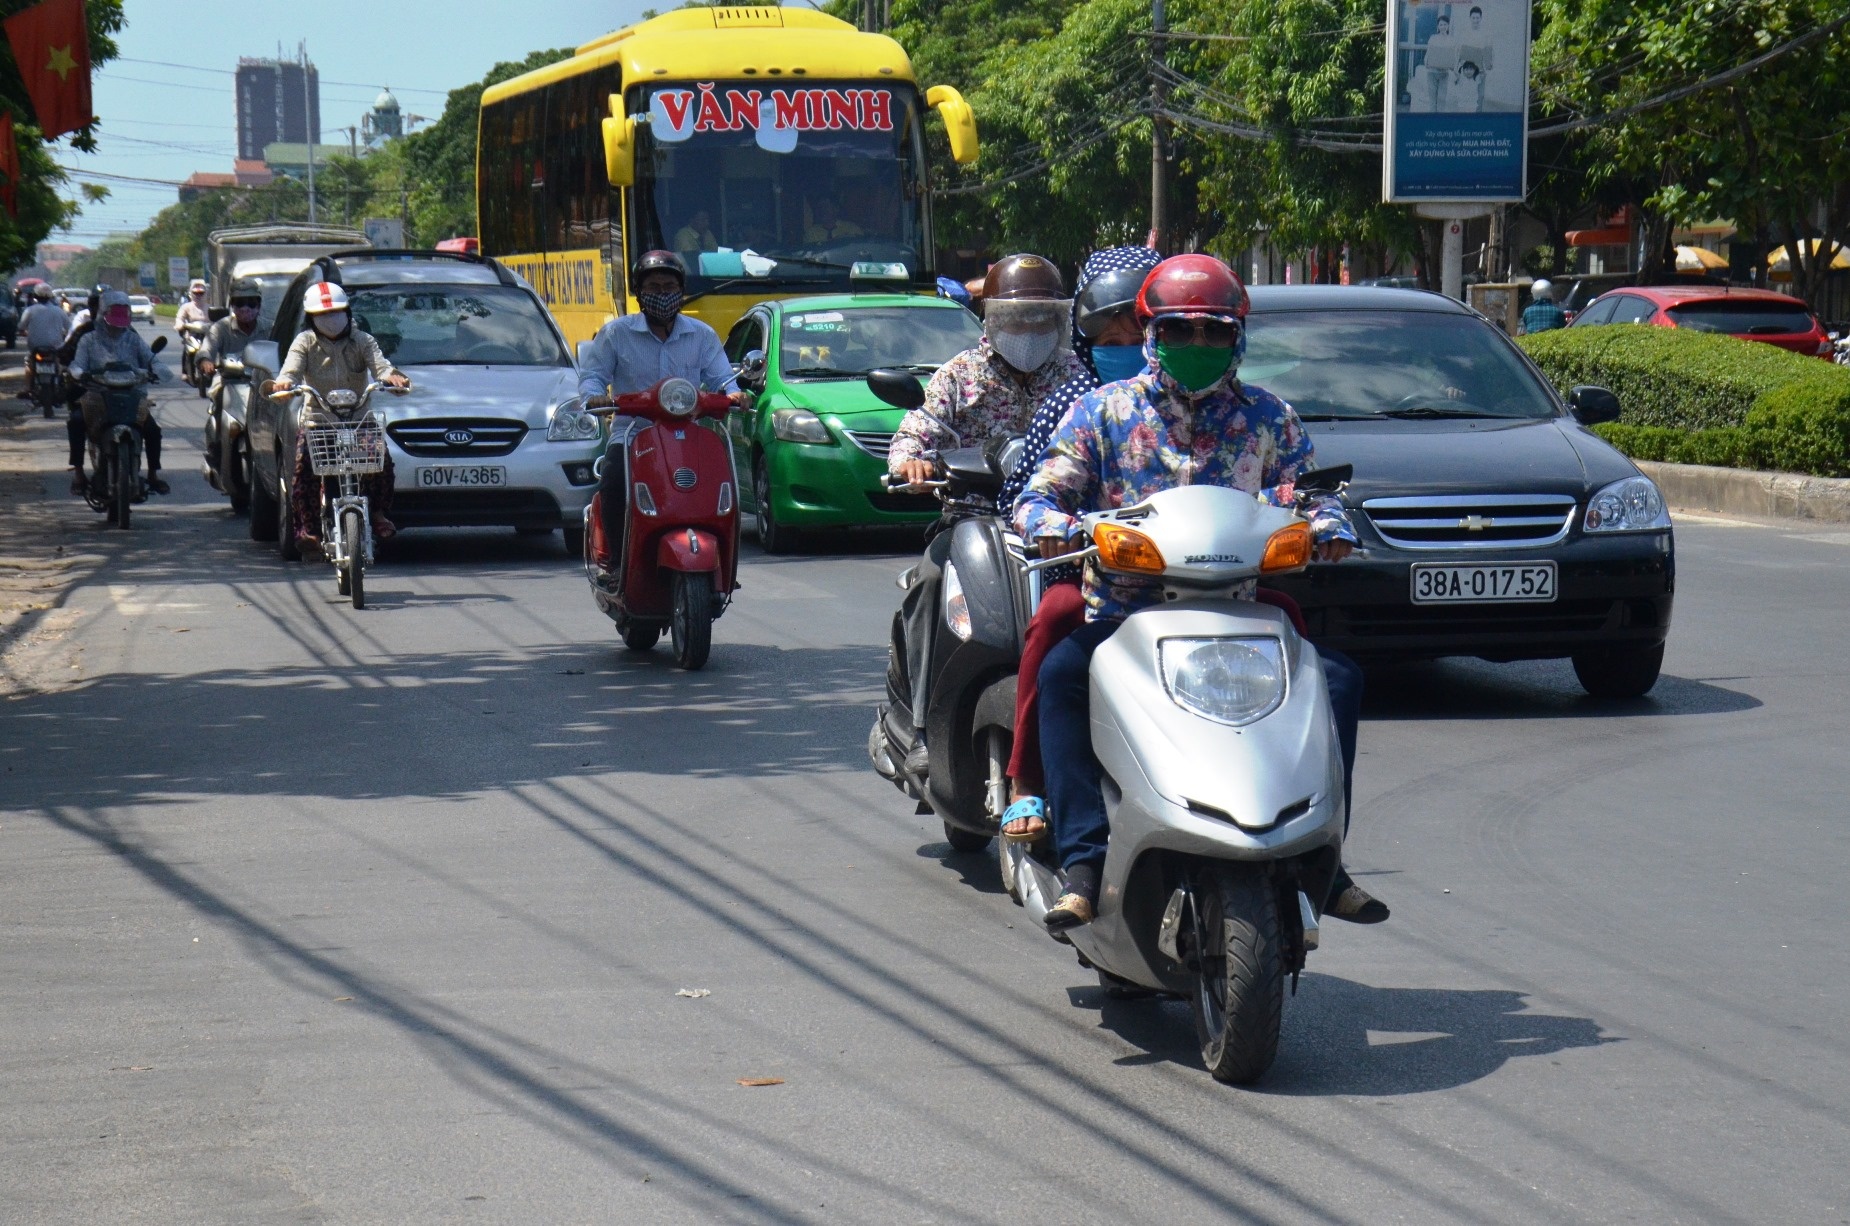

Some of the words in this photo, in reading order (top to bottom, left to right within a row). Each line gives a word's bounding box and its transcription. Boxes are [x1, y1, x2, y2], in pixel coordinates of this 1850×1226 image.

[658, 82, 762, 132] VĂN
[771, 89, 894, 131] MINH
[1480, 138, 1495, 147] NHÀ
[1409, 149, 1422, 157] XÂY
[1446, 149, 1456, 157] VÀ
[1493, 148, 1509, 157] NHÀ
[449, 433, 468, 441] KIA
[423, 467, 500, 485] 60V-4365
[1184, 554, 1244, 564] HONDA
[1419, 568, 1550, 597] 38A-017.52
